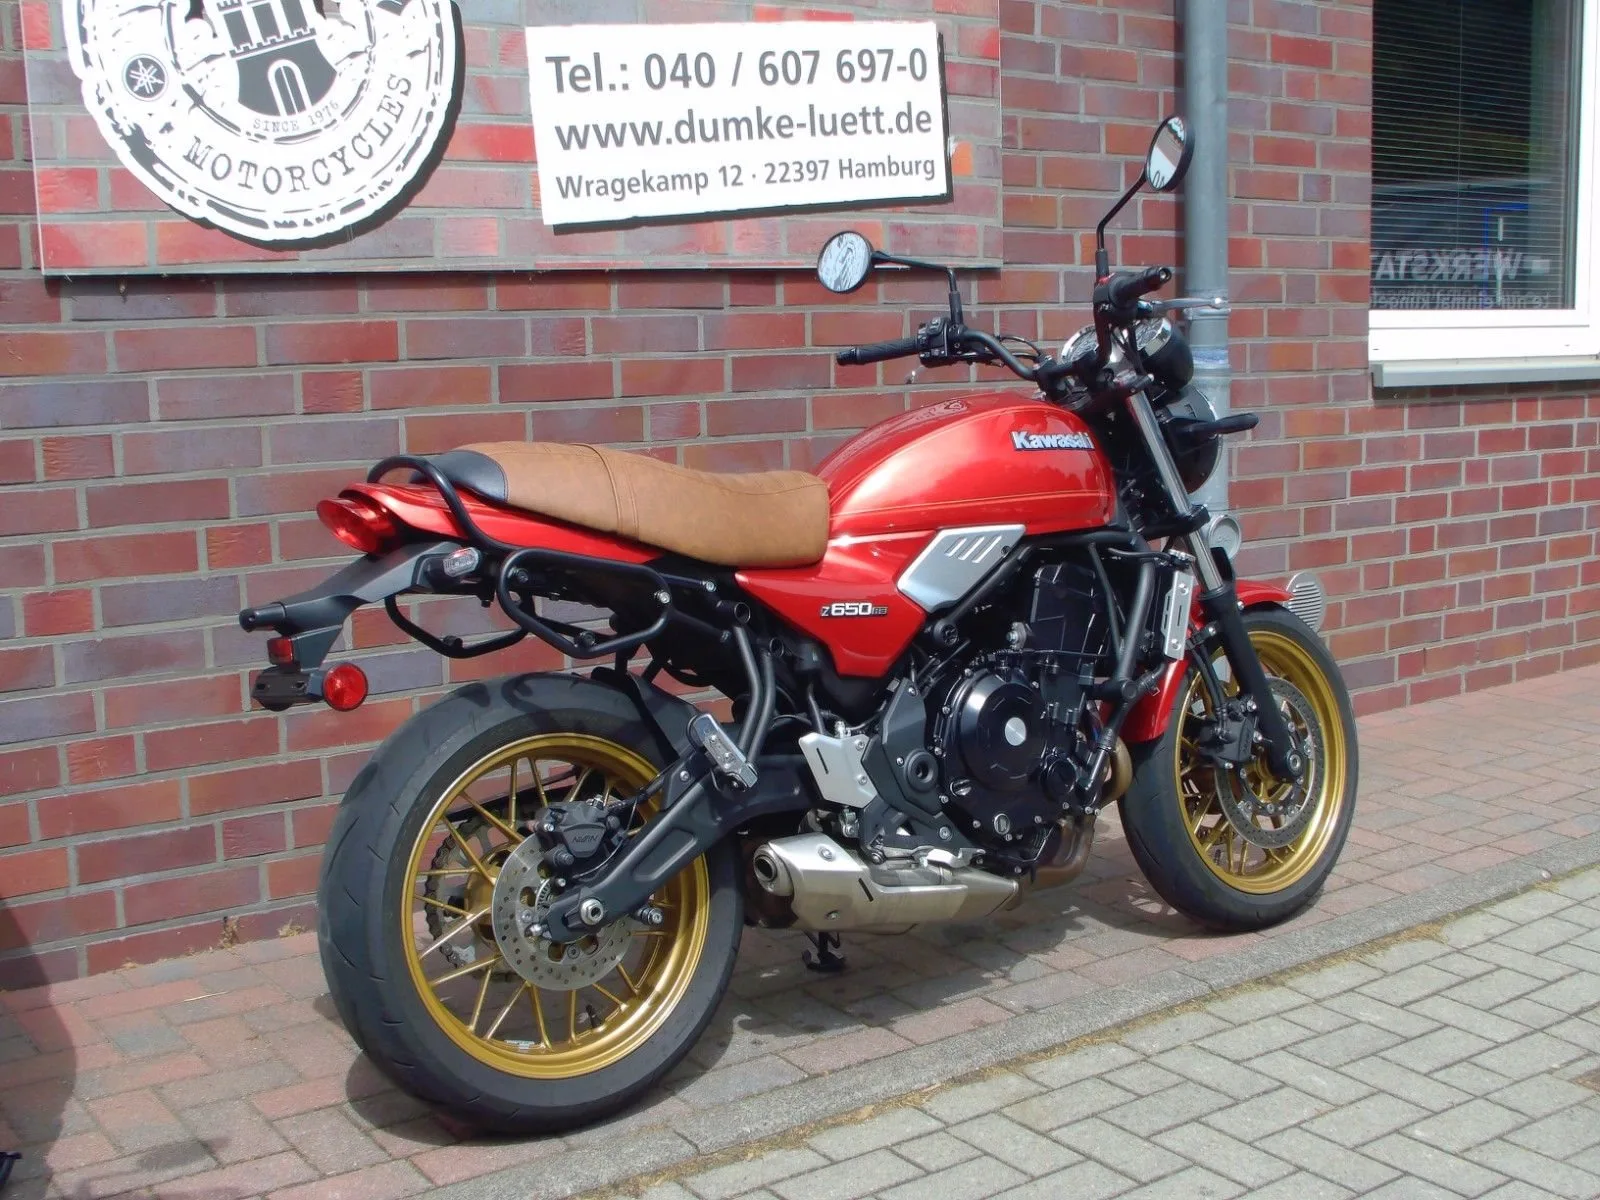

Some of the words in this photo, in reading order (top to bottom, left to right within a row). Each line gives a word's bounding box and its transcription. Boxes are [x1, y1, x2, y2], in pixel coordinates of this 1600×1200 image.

[545, 52, 629, 93] Tel.:
[645, 52, 715, 90] 040
[759, 50, 820, 85] 607
[837, 48, 927, 83] 697-0
[182, 73, 412, 195] MOTORCYCLES
[253, 118, 300, 132] SINCE
[308, 100, 339, 126] 1976
[555, 101, 931, 150] www.dumke-luett.de
[556, 169, 708, 201] Wragekamp
[719, 165, 743, 187] 12
[765, 160, 829, 184] 22397
[838, 155, 935, 180] Hamburg
[1012, 431, 1095, 449] Kawasaki
